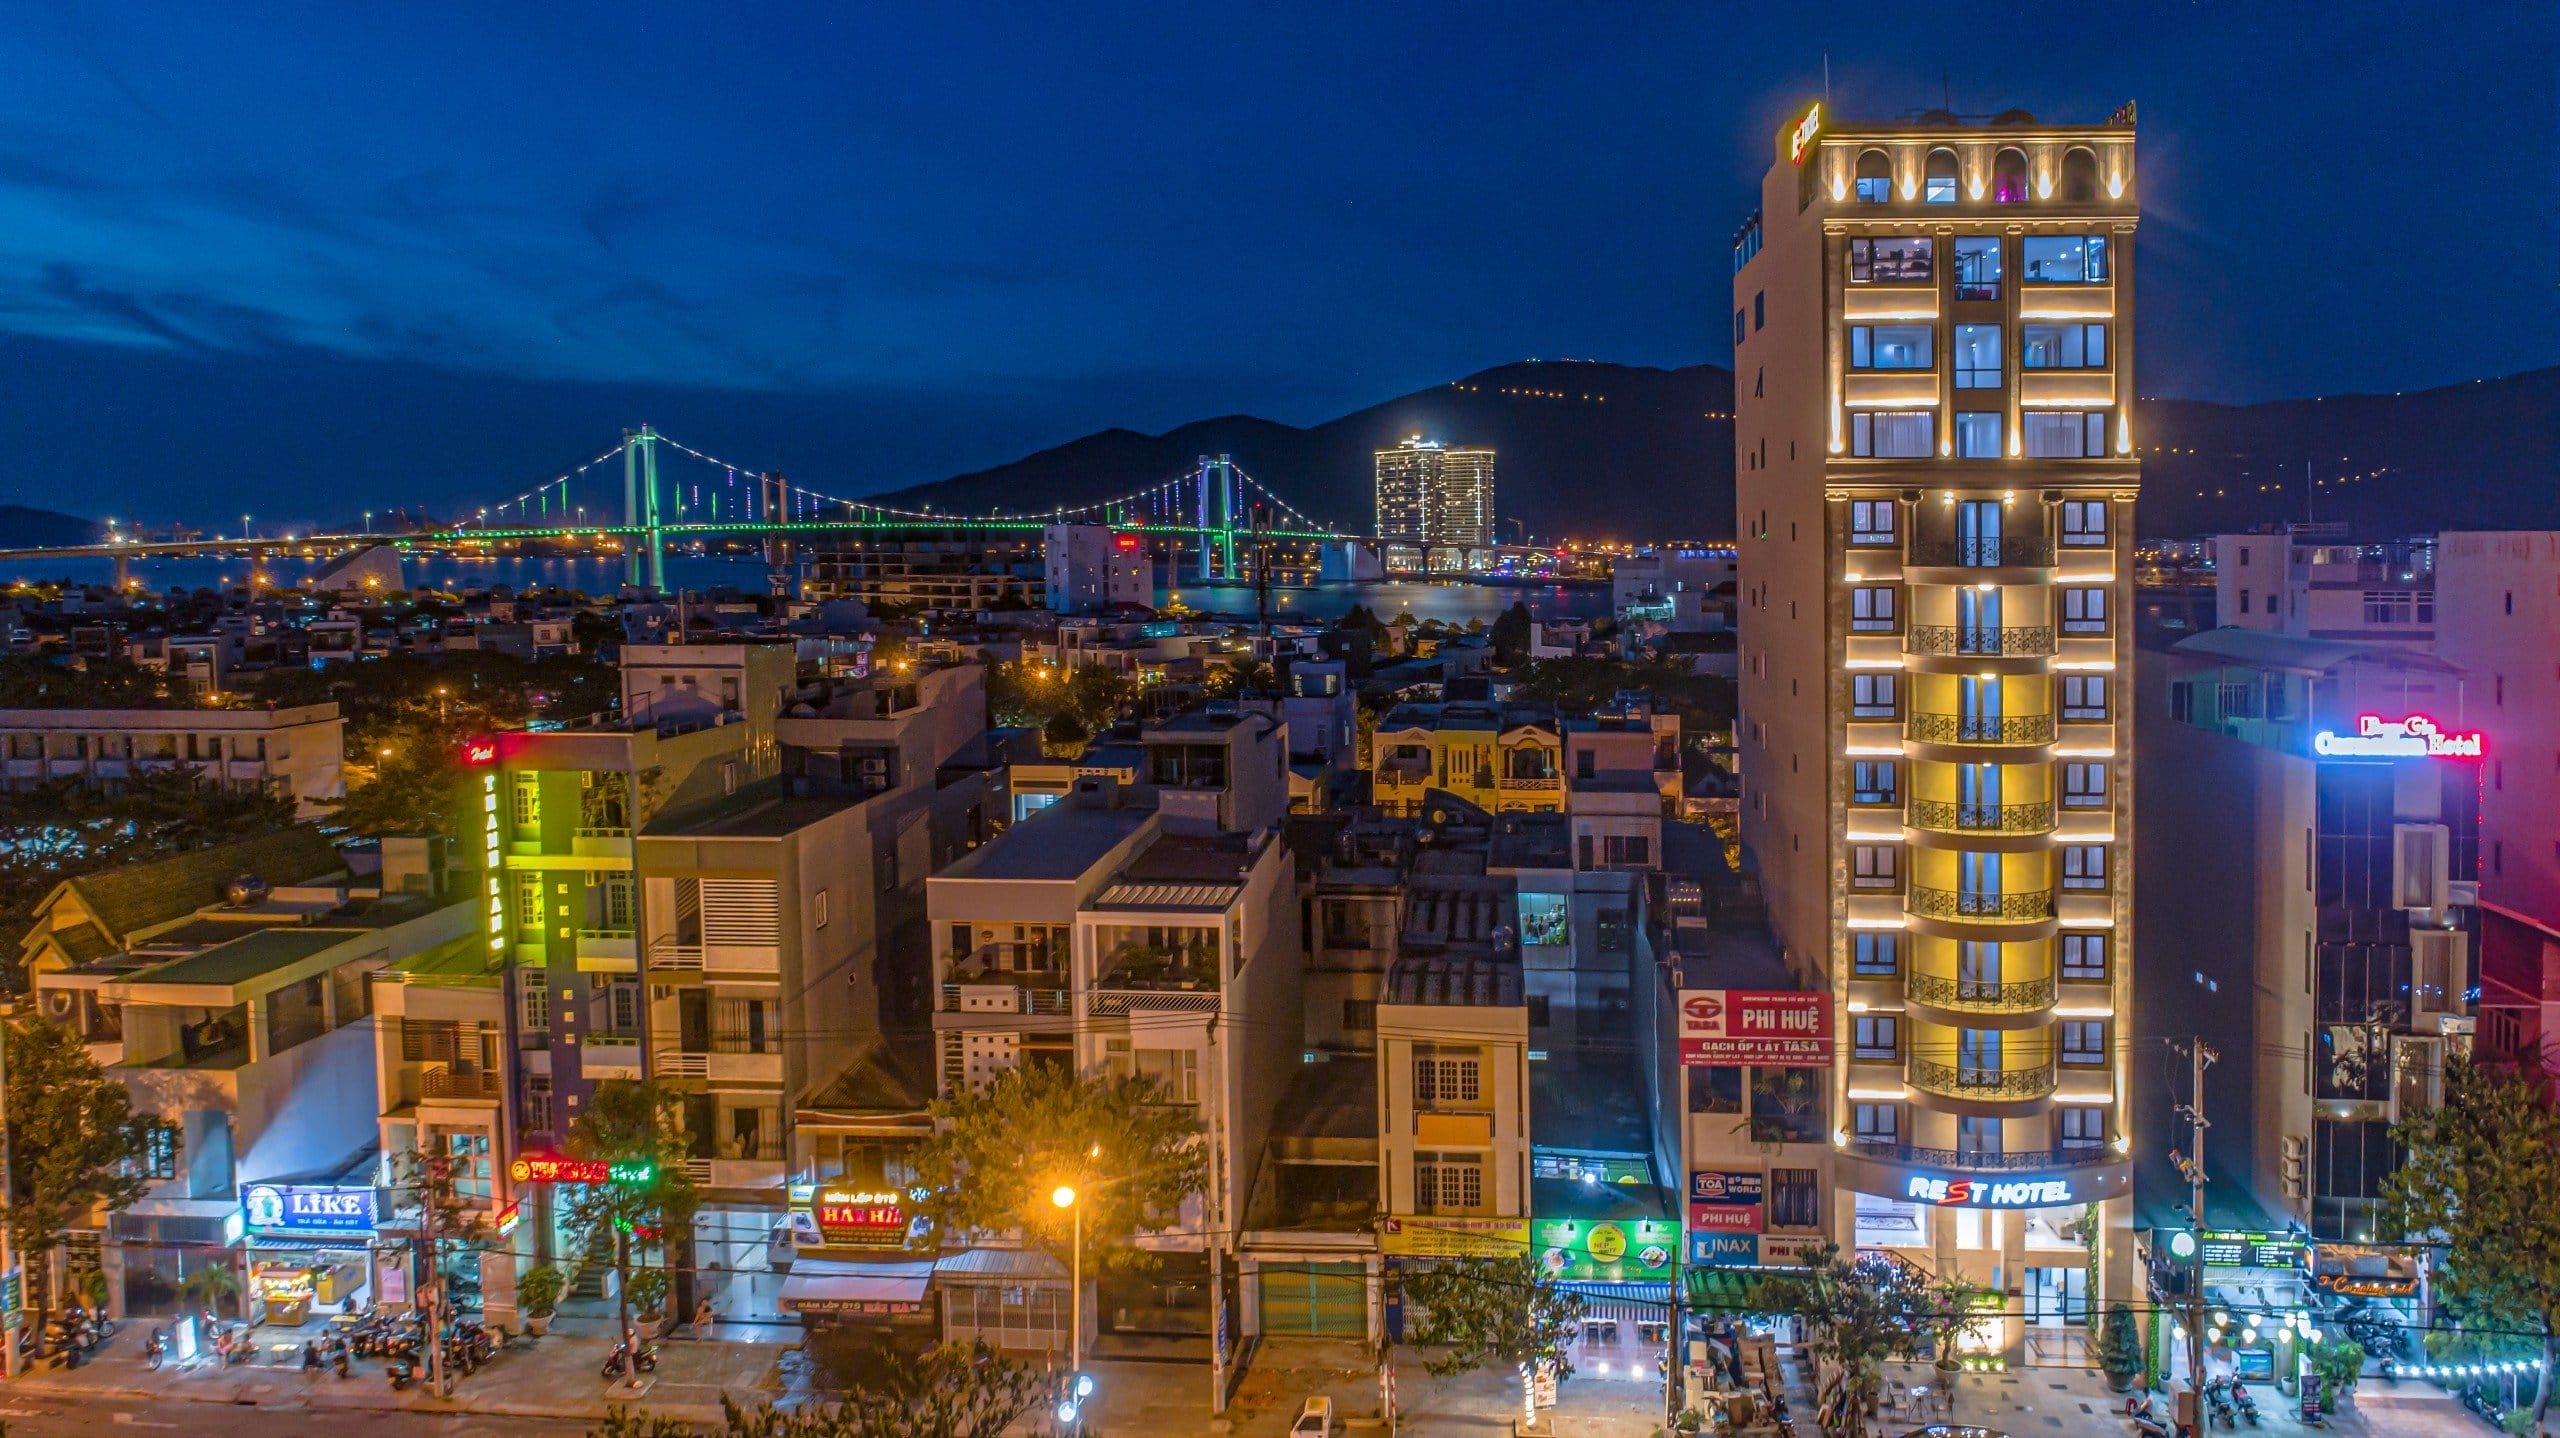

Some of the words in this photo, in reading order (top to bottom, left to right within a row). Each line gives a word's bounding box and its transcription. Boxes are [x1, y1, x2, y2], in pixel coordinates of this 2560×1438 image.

[2428, 733, 2482, 756] Hotel
[1686, 1021, 1721, 1030] TASA
[1743, 1009, 1776, 1030] PHI
[1781, 1006, 1819, 1034] HUỆ
[1782, 1041, 1820, 1052] TASA
[1699, 1179, 1723, 1189] TOA
[1728, 1185, 1762, 1194] WORLD
[1908, 1177, 1989, 1204] REST
[1991, 1181, 2072, 1204] HOTEL
[1702, 1213, 1722, 1223] PHI
[1725, 1212, 1751, 1227] HUỆ
[1713, 1238, 1751, 1253] INAX
[1769, 1246, 1790, 1256] PHI
